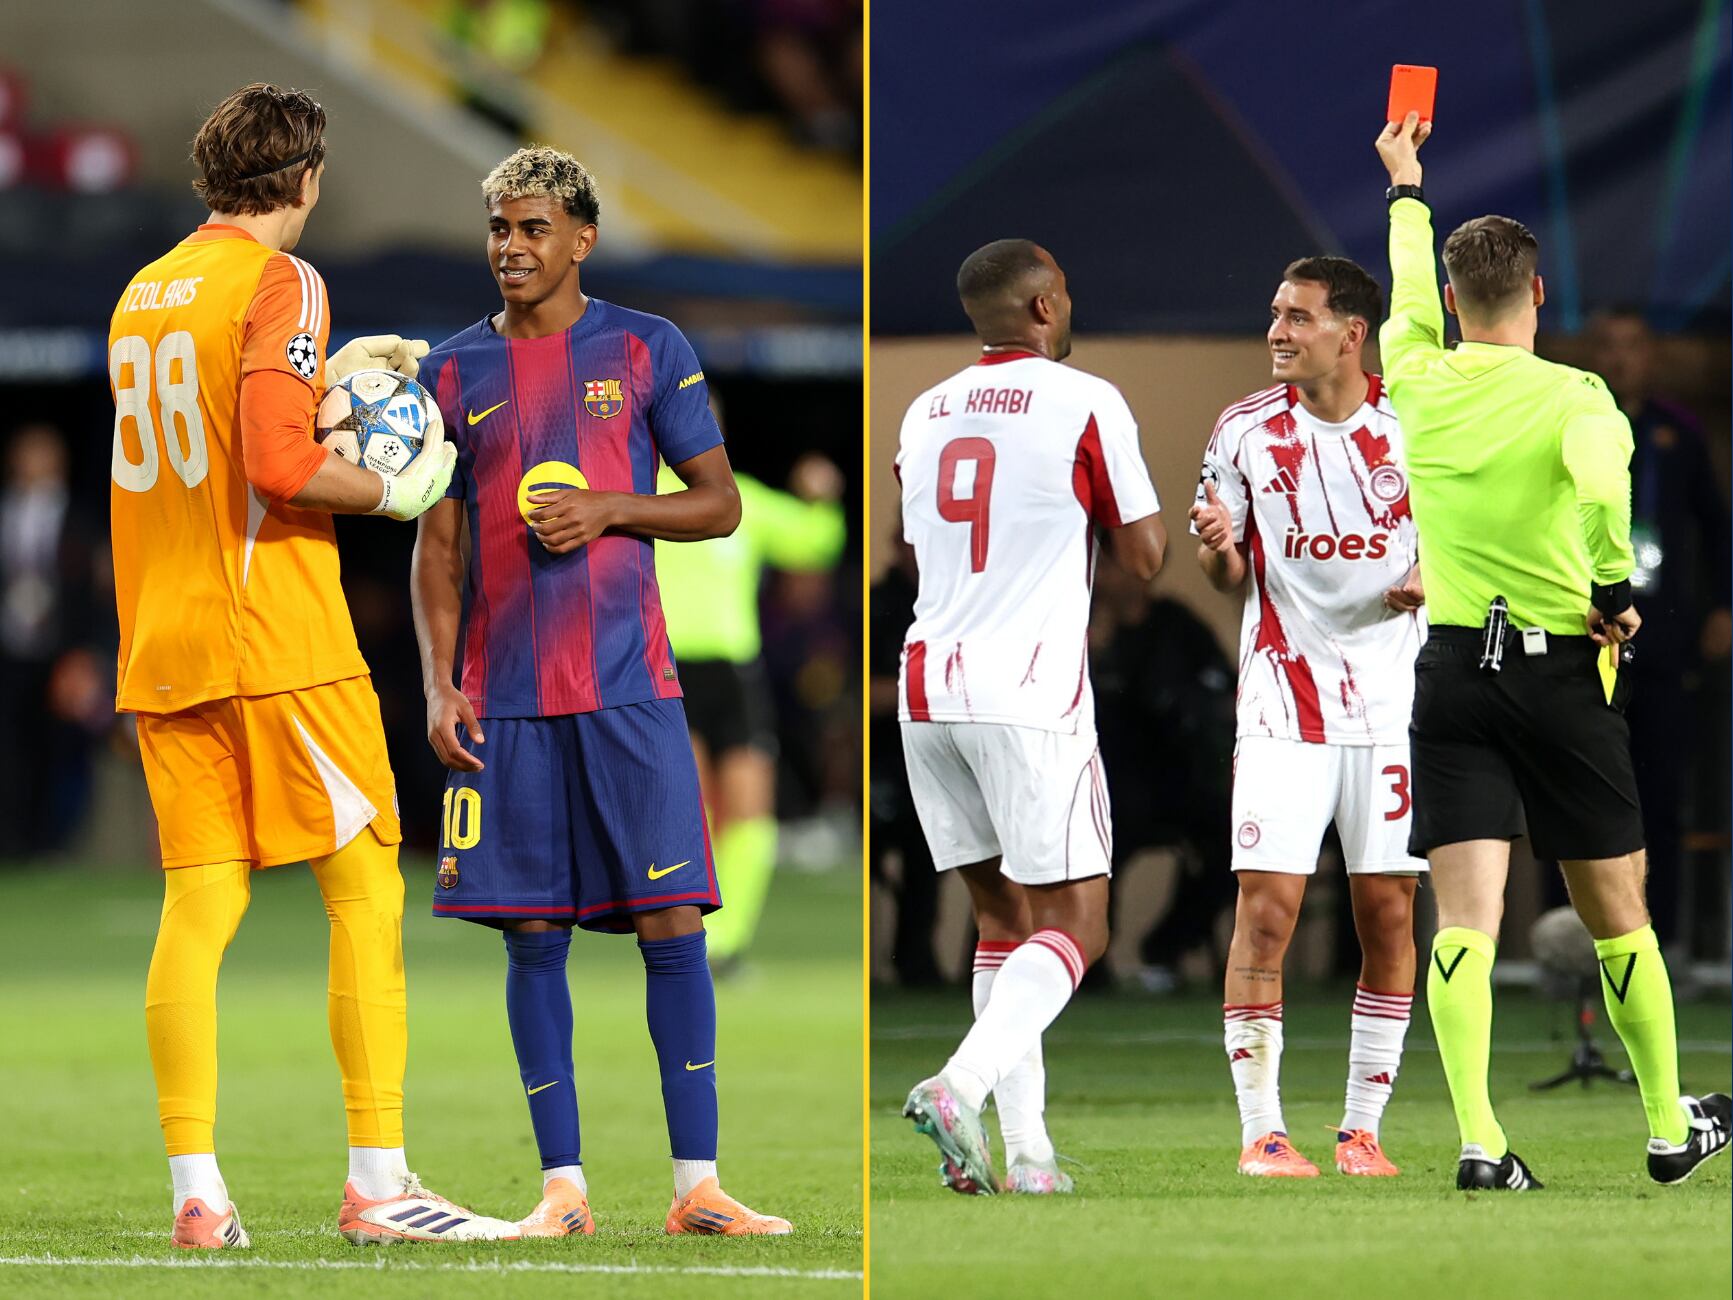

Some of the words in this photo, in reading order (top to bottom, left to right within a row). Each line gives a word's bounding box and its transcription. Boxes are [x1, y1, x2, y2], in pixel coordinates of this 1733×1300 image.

[123, 276, 204, 313] TZOLAKIS
[109, 330, 209, 493] 88
[928, 394, 951, 420] EL
[964, 388, 1034, 415] KAABI
[366, 454, 398, 474] CHAMPIONS
[936, 436, 997, 574] 9
[1284, 527, 1390, 561] iroes
[1381, 764, 1411, 822] 3
[443, 786, 482, 850] 10
